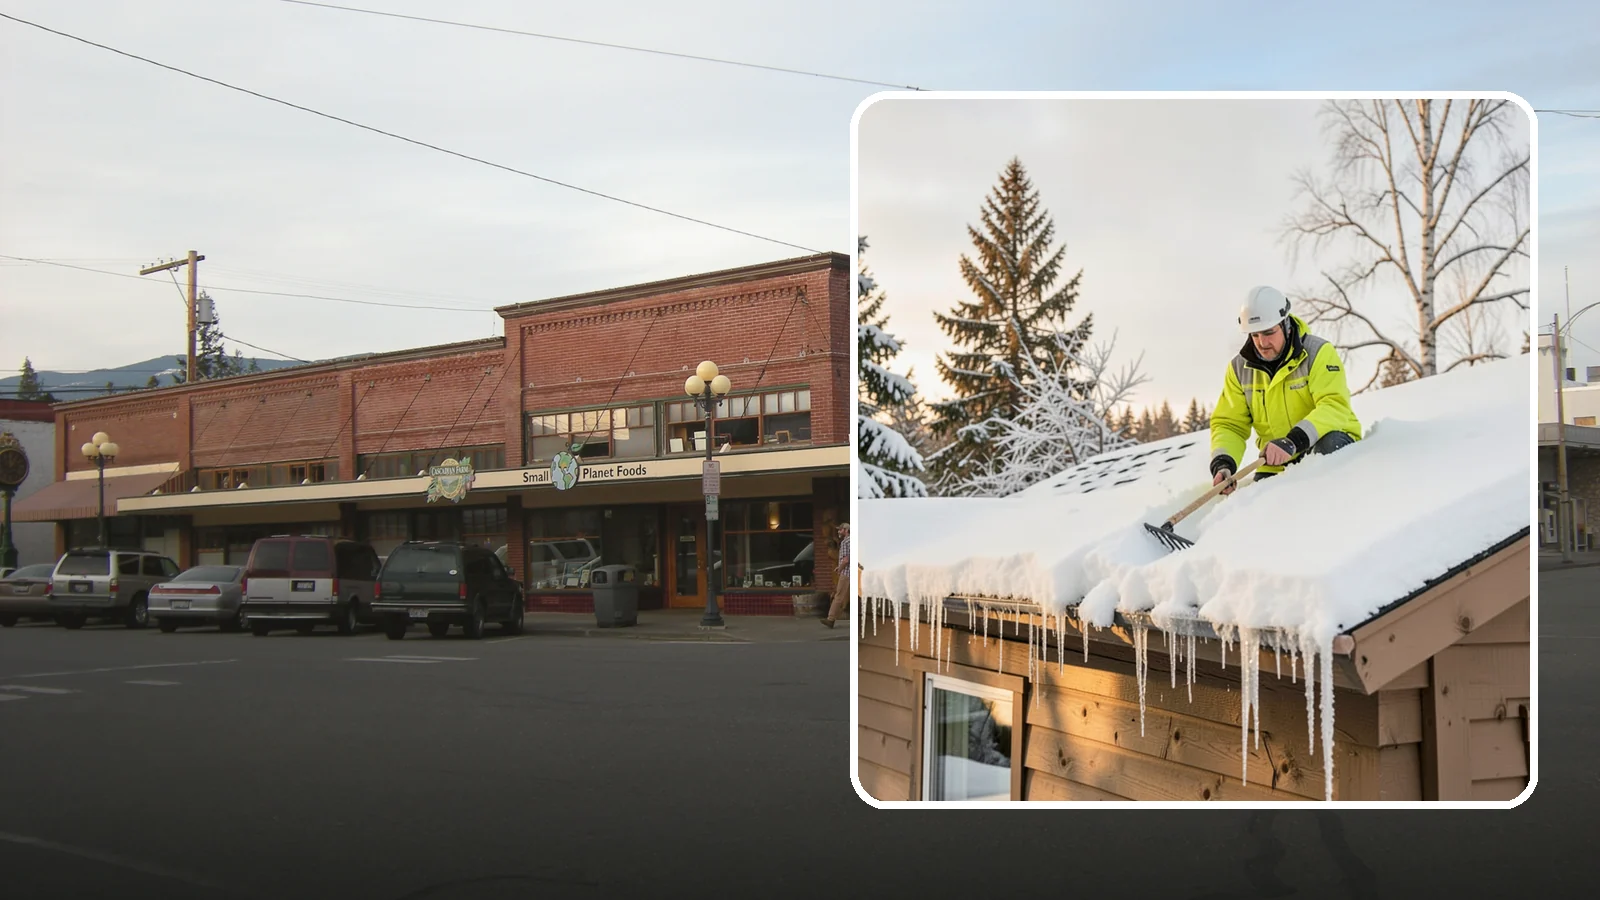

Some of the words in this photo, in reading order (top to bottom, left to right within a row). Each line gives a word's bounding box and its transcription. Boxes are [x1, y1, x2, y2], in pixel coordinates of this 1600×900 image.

[523, 470, 549, 482] Small
[583, 467, 614, 479] Planet
[617, 464, 647, 476] Foods
